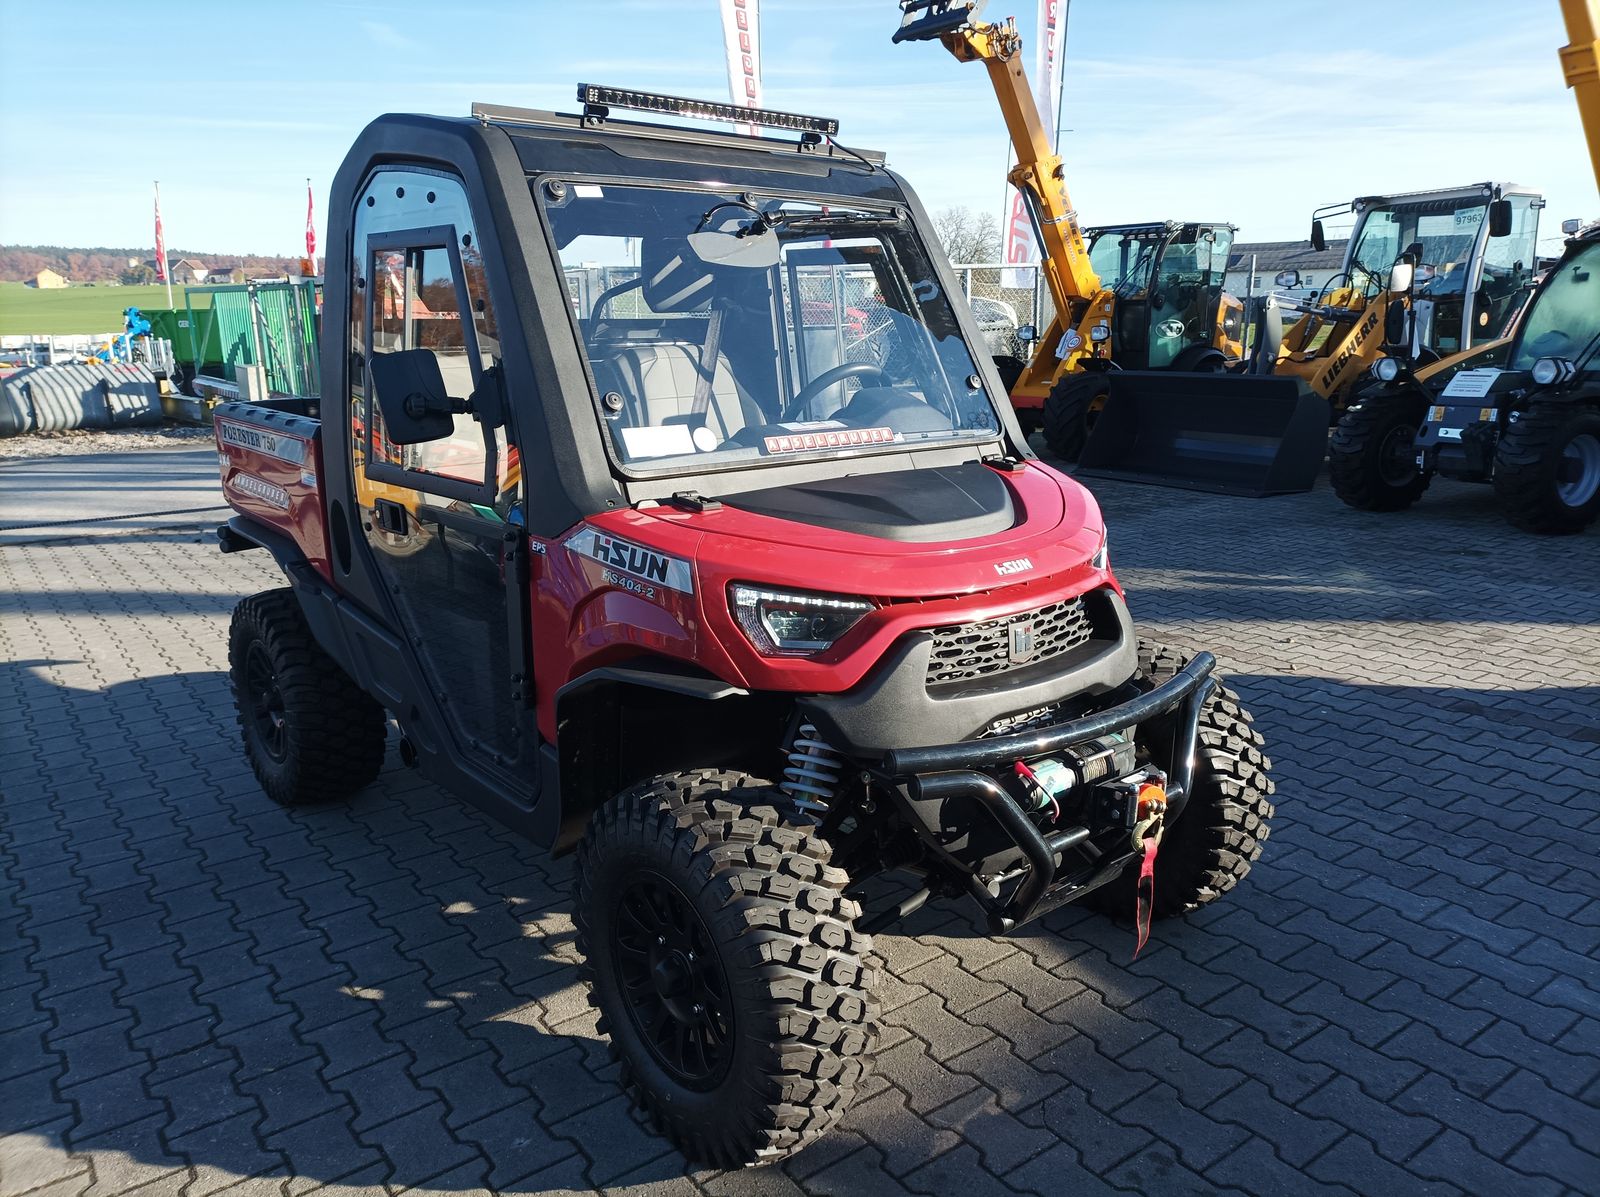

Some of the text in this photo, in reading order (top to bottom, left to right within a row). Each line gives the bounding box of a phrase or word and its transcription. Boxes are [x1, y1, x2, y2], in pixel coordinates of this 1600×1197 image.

[1456, 213, 1483, 226] 97963
[1322, 312, 1379, 389] LIEBHERR
[223, 424, 276, 452] FORESTER 750
[532, 541, 546, 554] EPS
[602, 569, 655, 599] HS404-2
